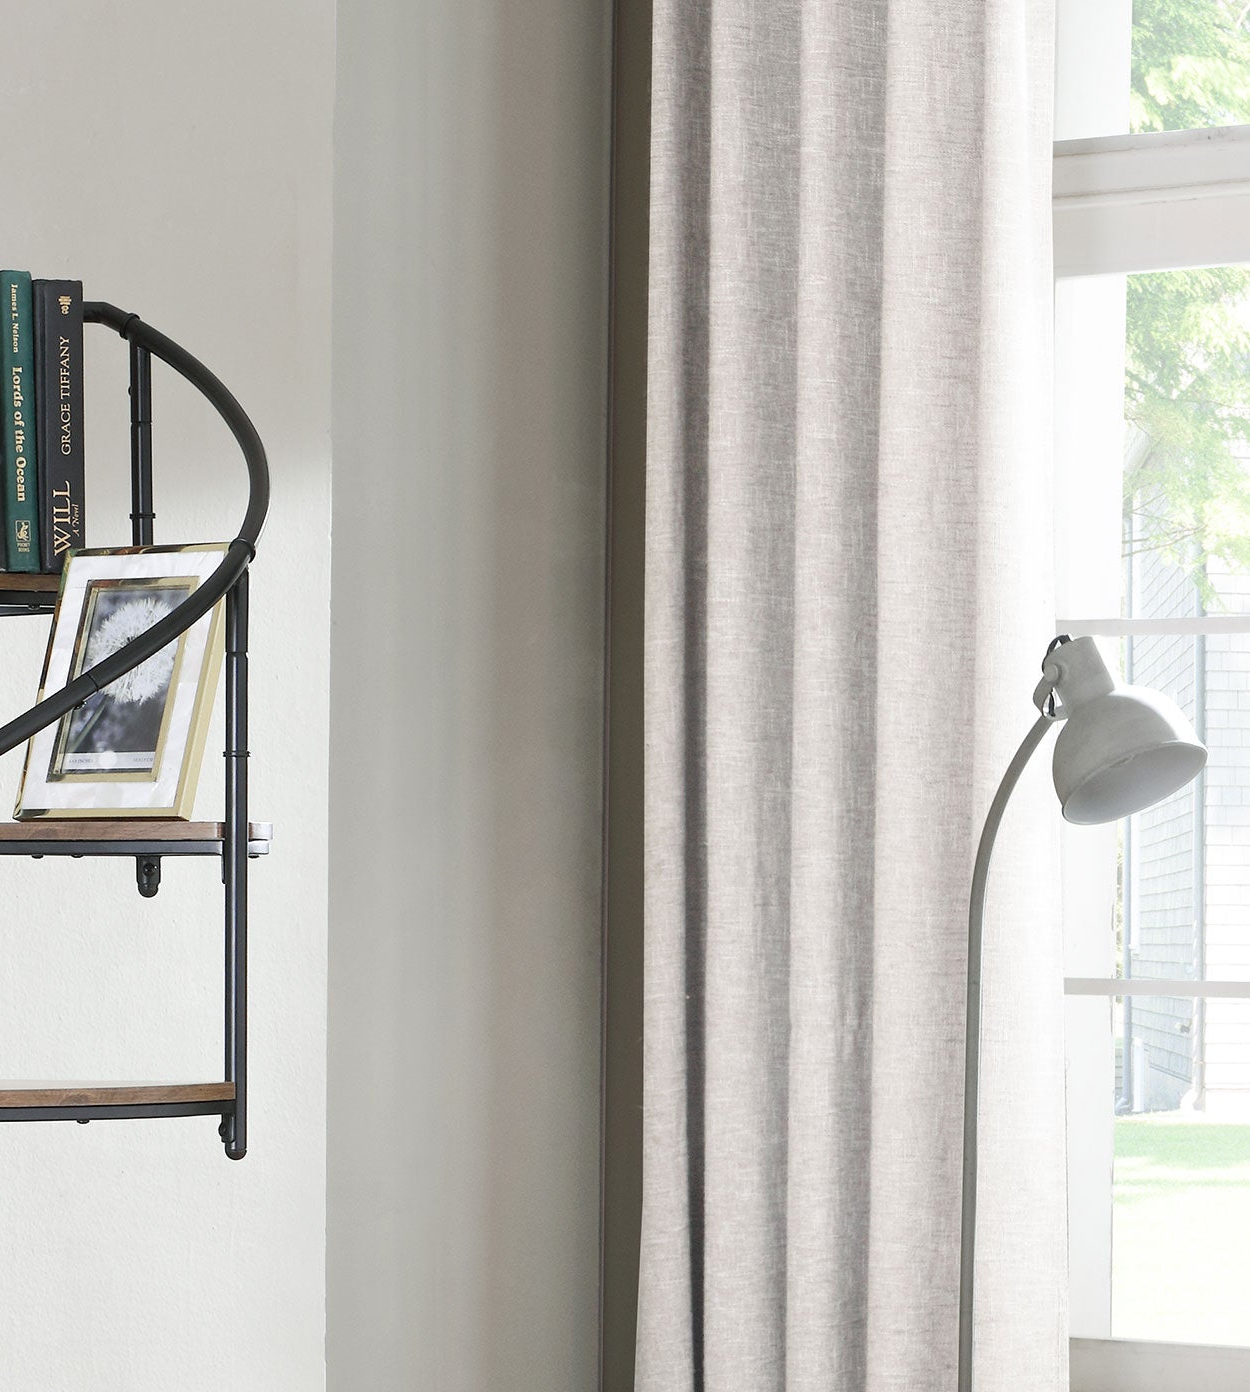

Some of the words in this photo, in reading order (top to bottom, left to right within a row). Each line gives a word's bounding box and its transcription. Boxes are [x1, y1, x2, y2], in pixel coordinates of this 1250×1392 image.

[11, 283, 19, 311] James
[12, 322, 20, 353] Nelson
[59, 336, 70, 400] TIFFANY
[12, 367, 24, 407] Lords
[13, 410, 25, 427] of
[60, 403, 72, 456] GRACE
[14, 430, 26, 453] the
[15, 456, 27, 502] Ocean
[53, 480, 72, 557] WILL
[71, 503, 80, 525] Novel
[73, 529, 80, 537] A
